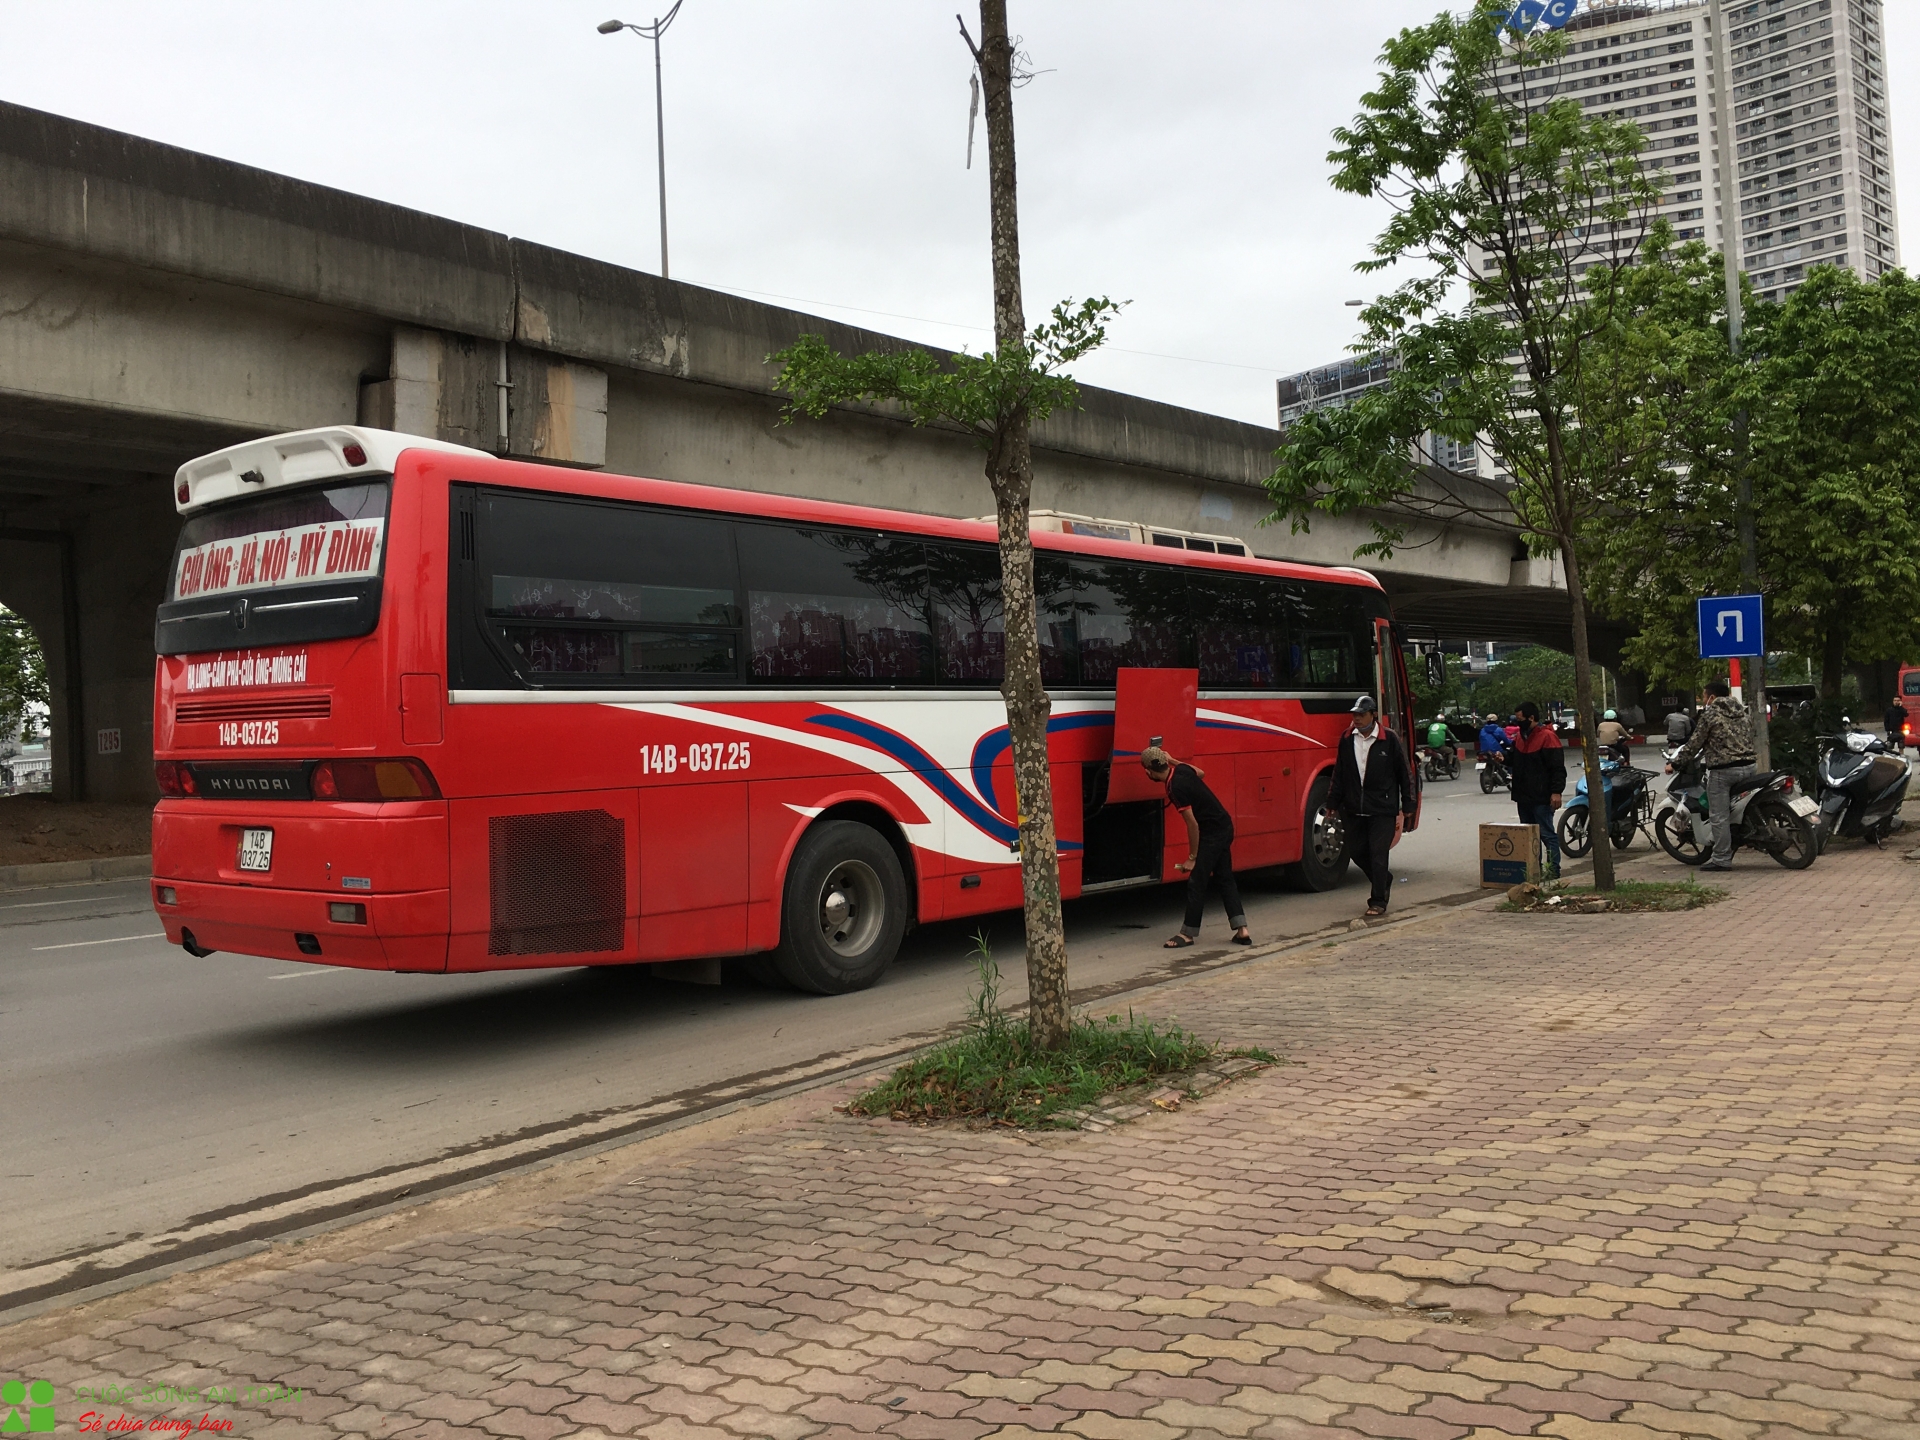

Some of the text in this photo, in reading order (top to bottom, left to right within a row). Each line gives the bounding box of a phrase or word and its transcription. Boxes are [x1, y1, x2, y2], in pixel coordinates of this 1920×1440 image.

[203, 543, 233, 591] ÔNG
[237, 536, 258, 585] HÀ
[259, 531, 291, 587] NỘI
[296, 525, 326, 577] MỸ
[325, 523, 378, 574] ĐÌNH
[99, 731, 119, 751] T295
[218, 721, 279, 746] 14B-037.25
[640, 742, 751, 774] 14B-037.25
[211, 778, 291, 790] HYUNDAI
[251, 831, 266, 849] 14B
[241, 849, 270, 868] 037.25
